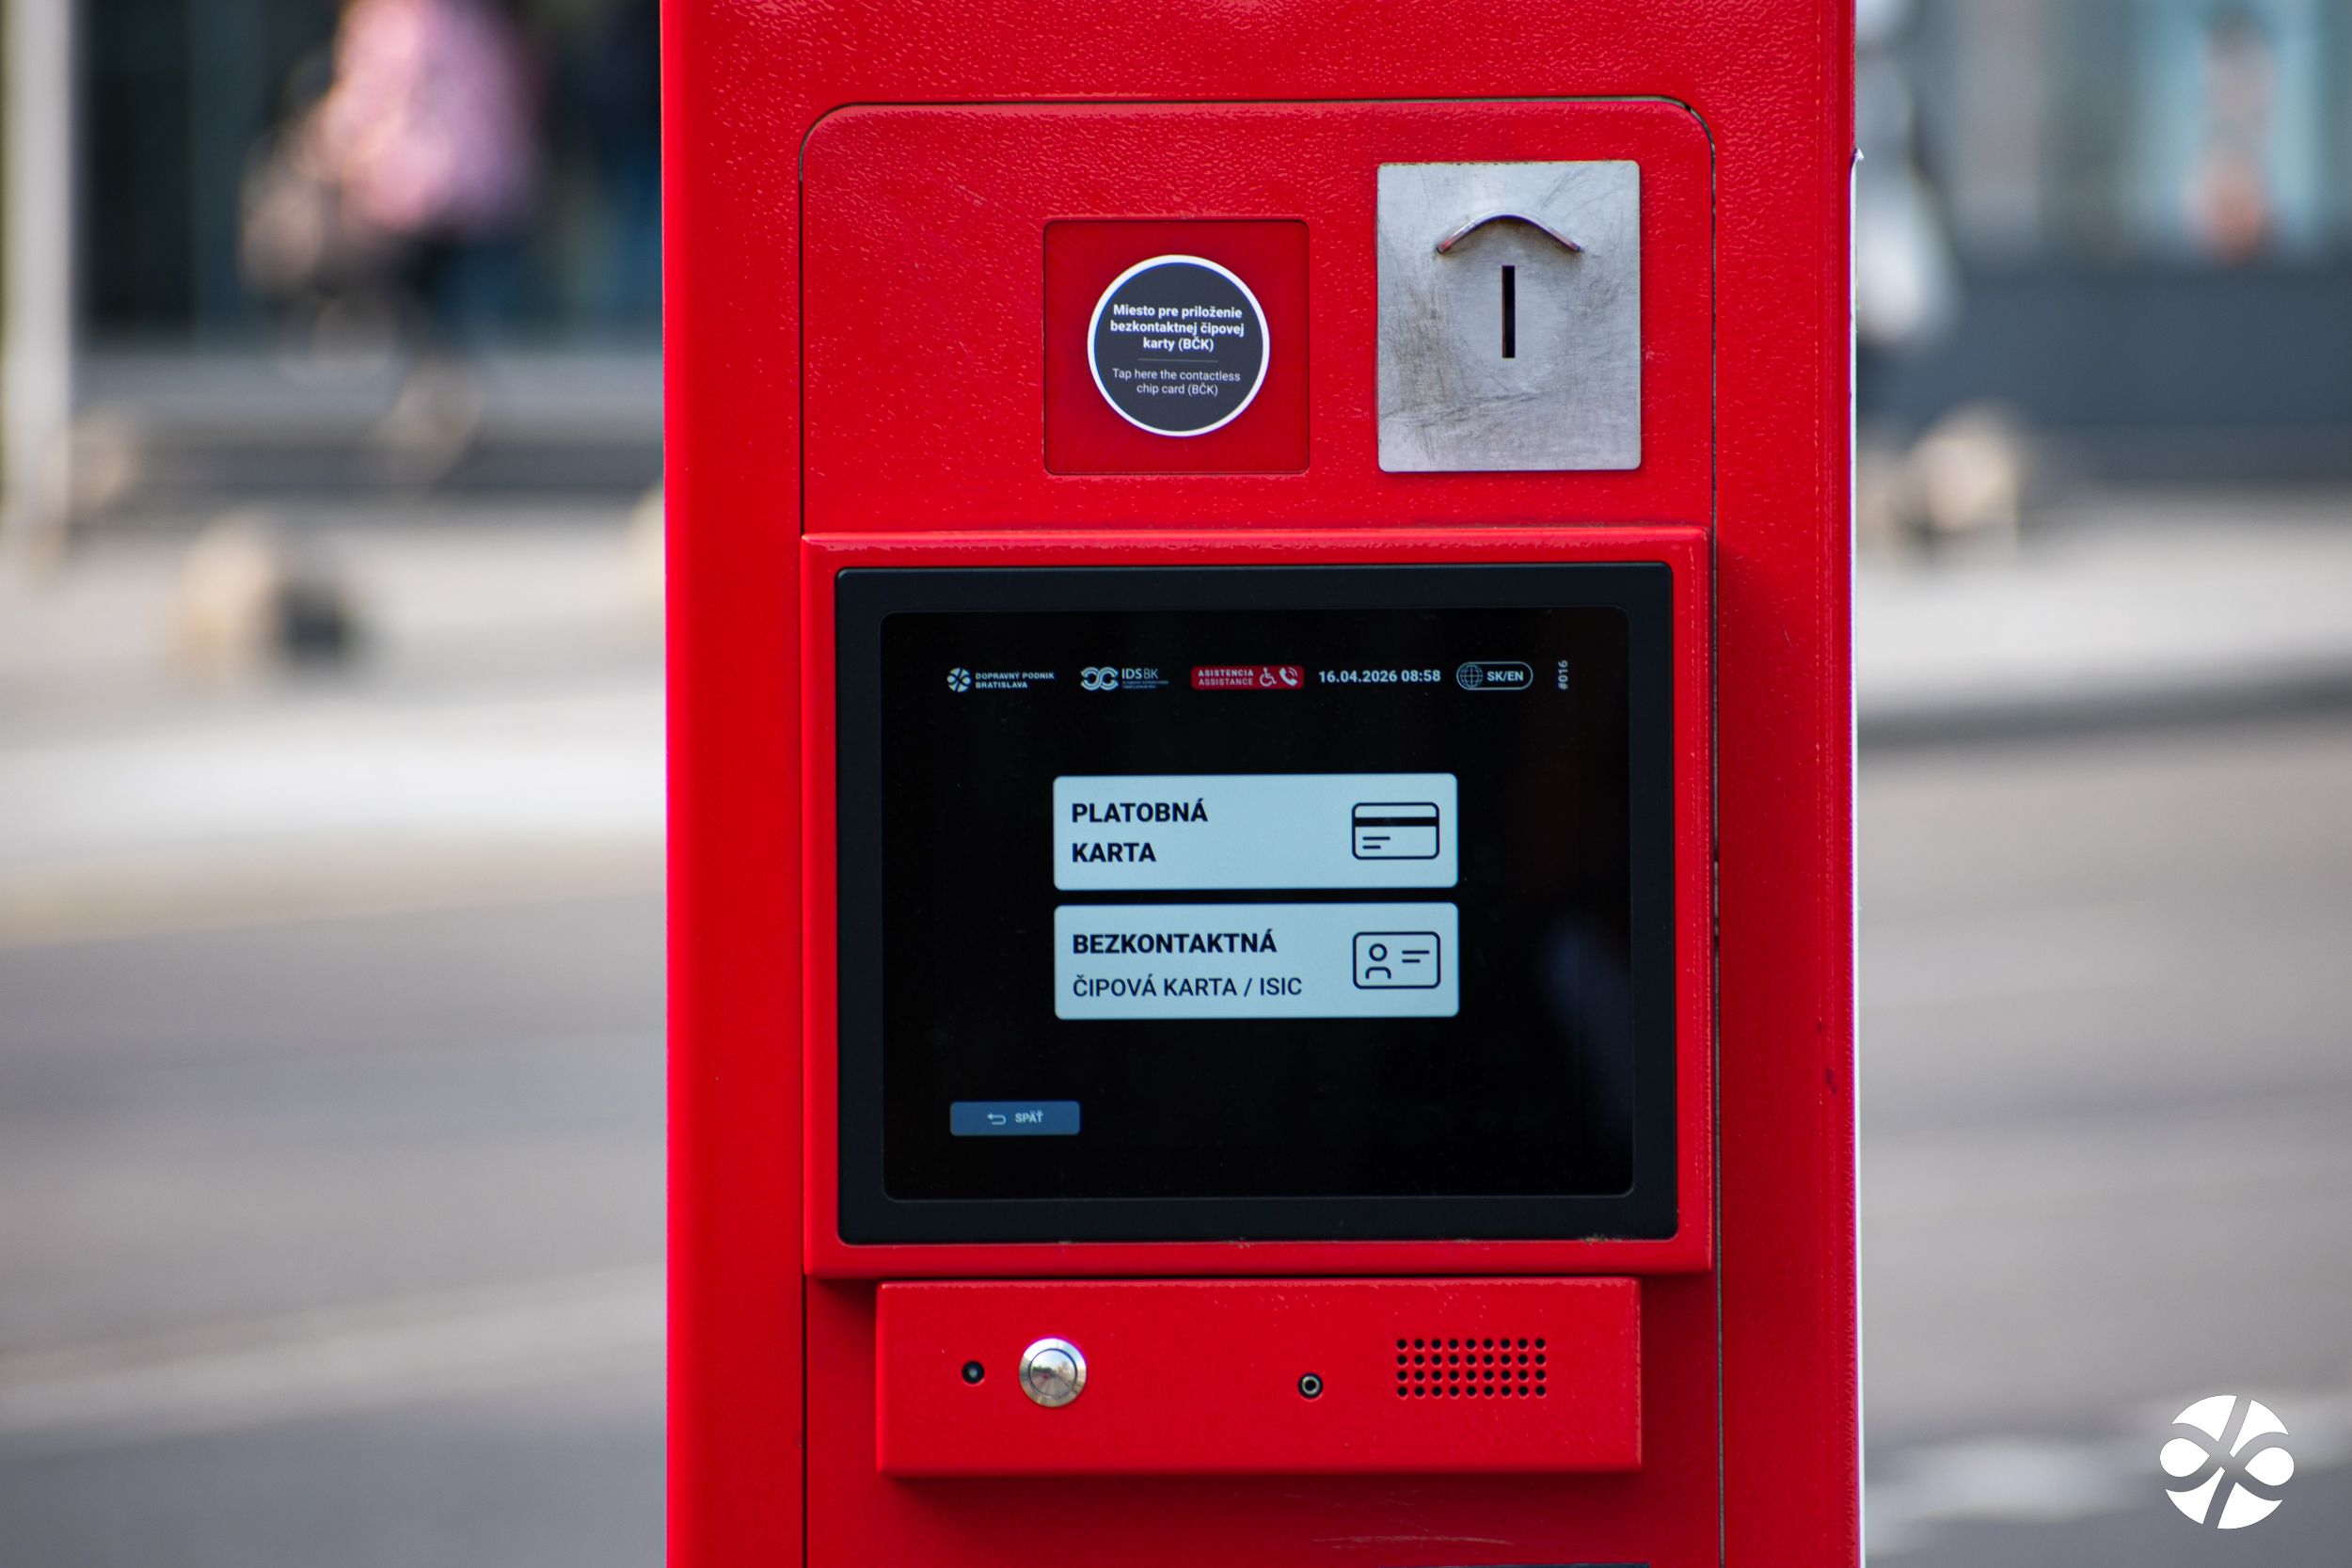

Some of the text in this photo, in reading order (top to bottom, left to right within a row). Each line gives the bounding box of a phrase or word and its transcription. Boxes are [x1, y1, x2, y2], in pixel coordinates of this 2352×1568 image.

[1113, 304, 1243, 320] Miesto pre priloženie
[1110, 320, 1245, 338] bezkontaktnej čipovej
[1143, 336, 1215, 353] karty (BČK)
[1112, 368, 1241, 382] Tap here the contactless
[1136, 383, 1218, 397] chip card (BČK)
[1198, 669, 1254, 677] ASISTENCIA
[1318, 670, 1441, 683] 16.04.2026 08:58
[1486, 671, 1524, 682] SK/EN
[1557, 659, 1568, 691] #016
[1198, 677, 1254, 686] ASSISTANCE
[1071, 798, 1208, 823] PLATOBNÁ
[1071, 843, 1156, 863] KARTA
[1072, 928, 1278, 955] BEZKONTAKTNÁ
[1073, 974, 1303, 997] ČIPOVÁ KARTA / ISIC
